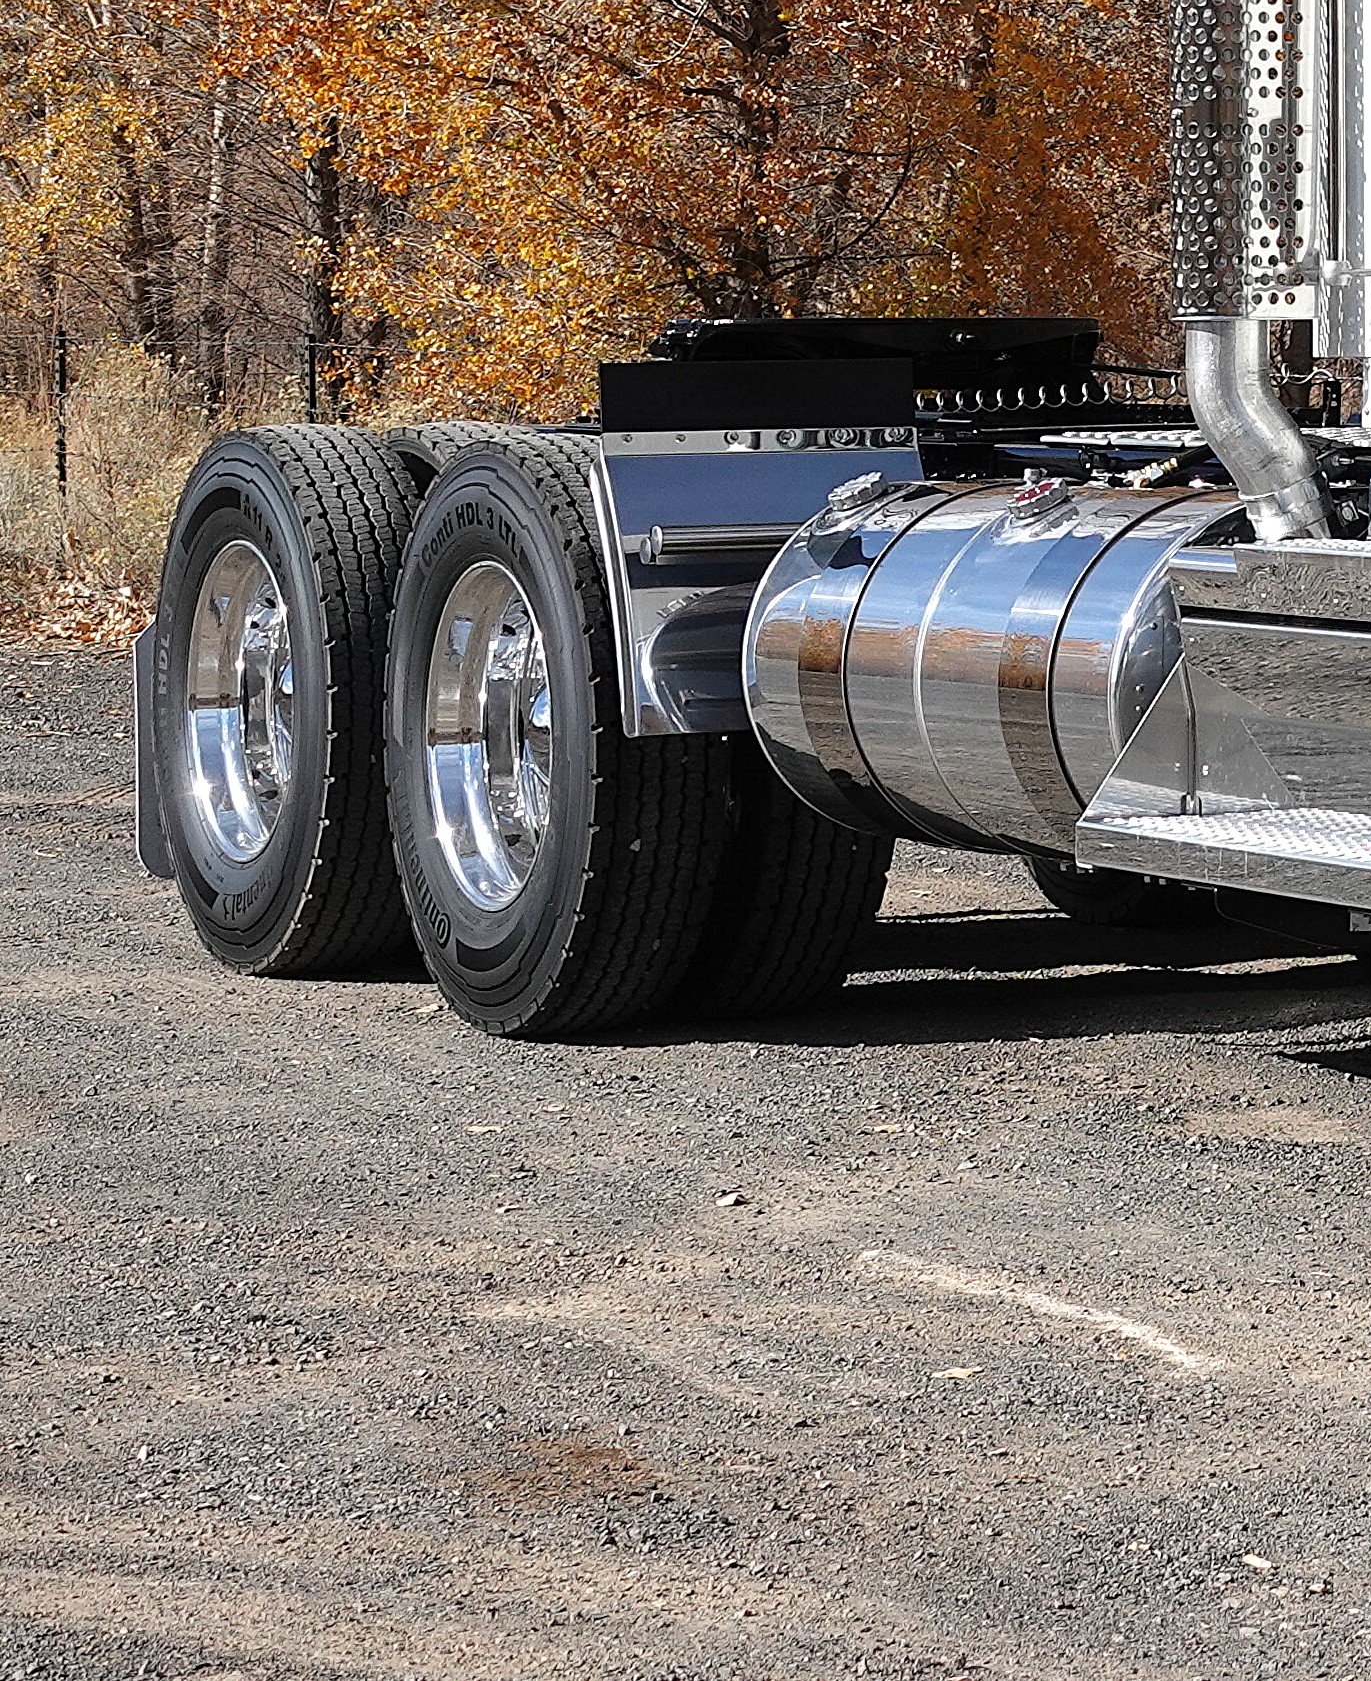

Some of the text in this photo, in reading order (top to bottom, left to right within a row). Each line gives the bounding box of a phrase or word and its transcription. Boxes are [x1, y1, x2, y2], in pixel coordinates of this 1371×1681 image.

[421, 511, 454, 568] Conti
[455, 502, 483, 529] HDL
[486, 507, 494, 530] 3
